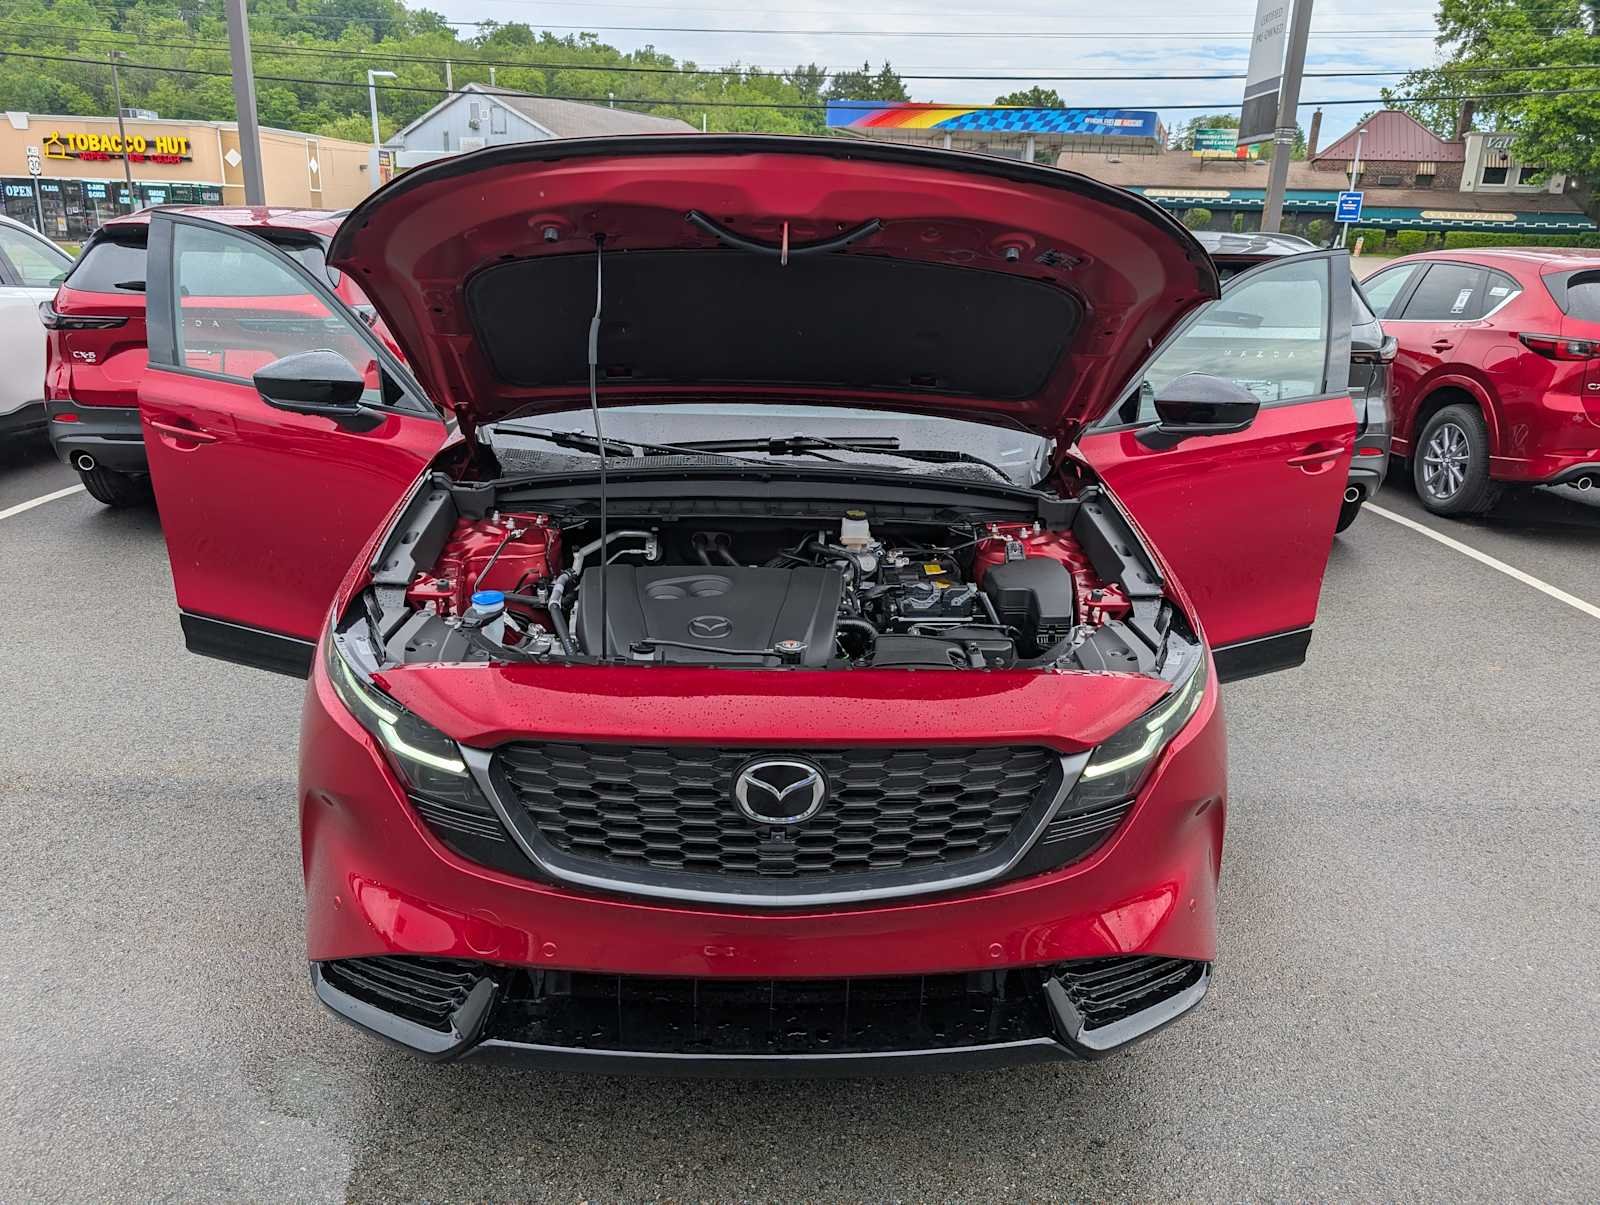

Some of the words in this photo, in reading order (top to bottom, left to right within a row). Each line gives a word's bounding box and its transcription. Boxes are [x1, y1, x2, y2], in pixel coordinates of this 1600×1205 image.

[66, 133, 146, 153] TOBACCO
[155, 136, 188, 154] HUT
[30, 159, 40, 171] 30
[5, 185, 33, 197] OPEN
